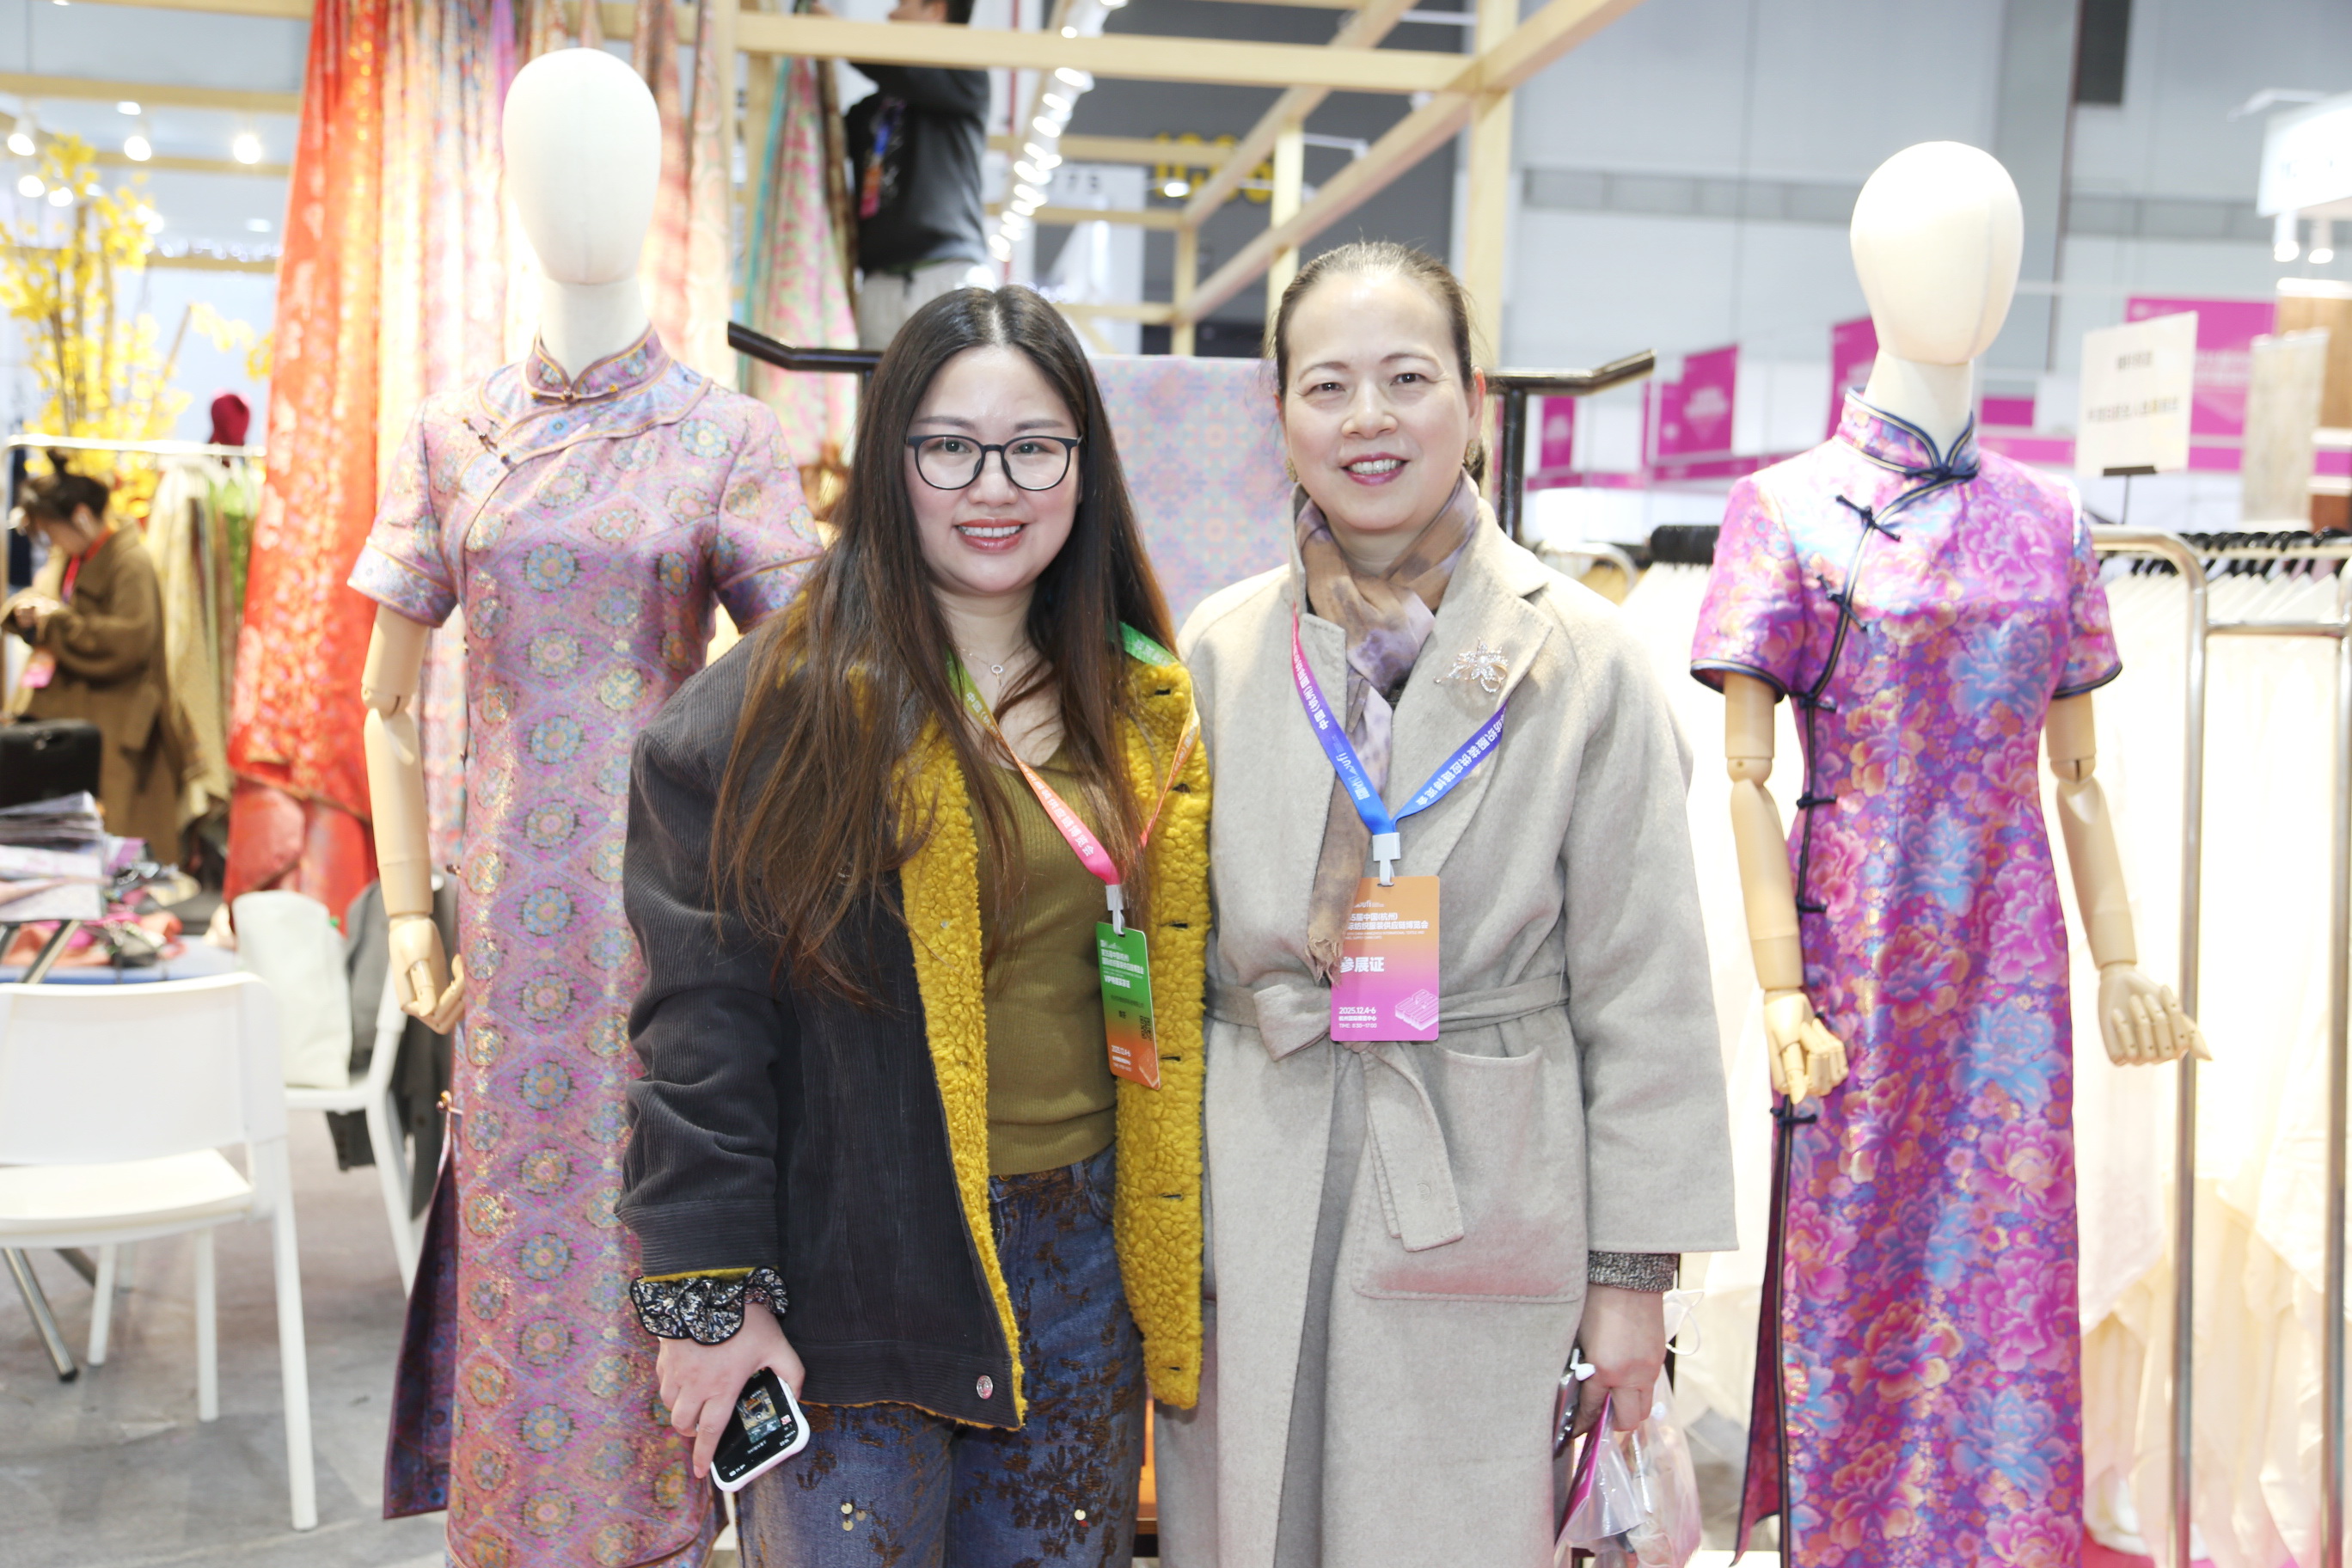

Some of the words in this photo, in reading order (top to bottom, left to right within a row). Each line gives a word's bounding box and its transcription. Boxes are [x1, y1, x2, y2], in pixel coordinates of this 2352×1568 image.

[1351, 912, 1399, 922] 5届中国(杭州)
[1340, 957, 1385, 973] 参展证
